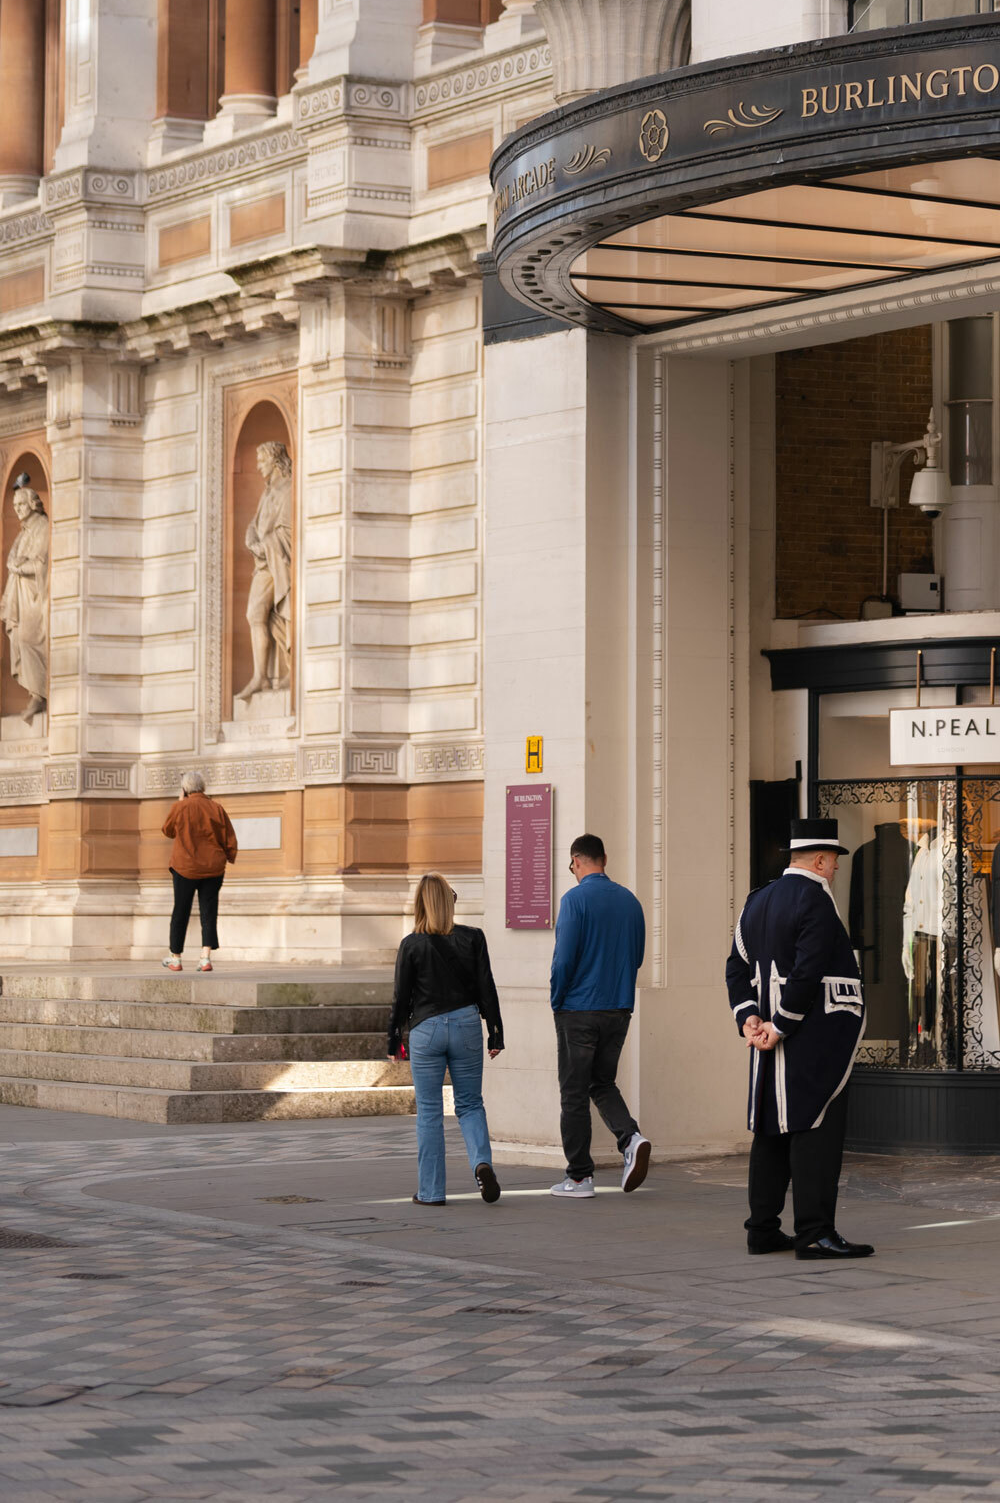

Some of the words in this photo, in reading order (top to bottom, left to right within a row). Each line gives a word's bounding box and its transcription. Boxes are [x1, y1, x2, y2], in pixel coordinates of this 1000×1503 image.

[512, 157, 556, 206] ARCADE
[911, 718, 996, 738] N.PEAL
[528, 739, 539, 769] H
